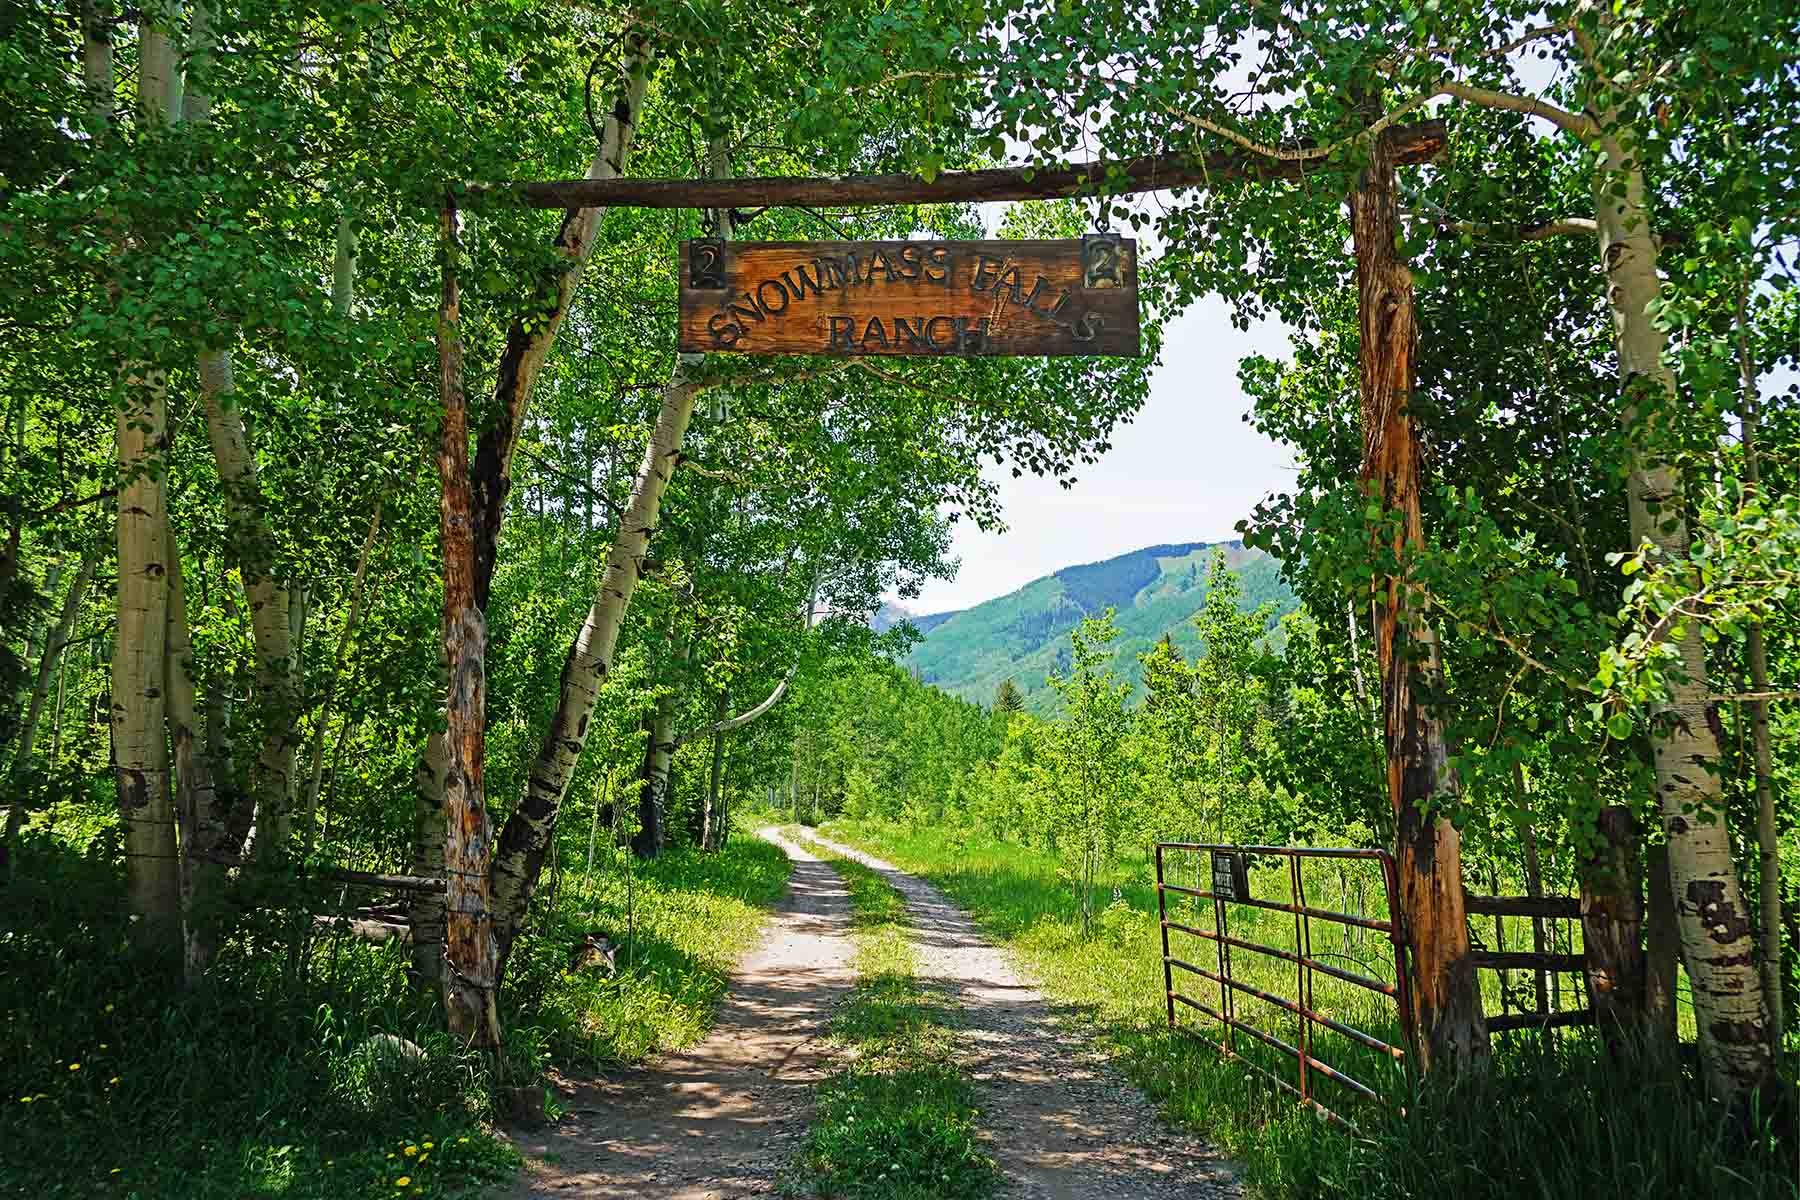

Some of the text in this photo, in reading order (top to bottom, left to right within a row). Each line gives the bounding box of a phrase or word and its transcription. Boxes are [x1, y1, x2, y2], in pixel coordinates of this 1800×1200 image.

[708, 245, 1105, 346] SNOWMASS FALLS
[829, 315, 992, 353] RANCH
